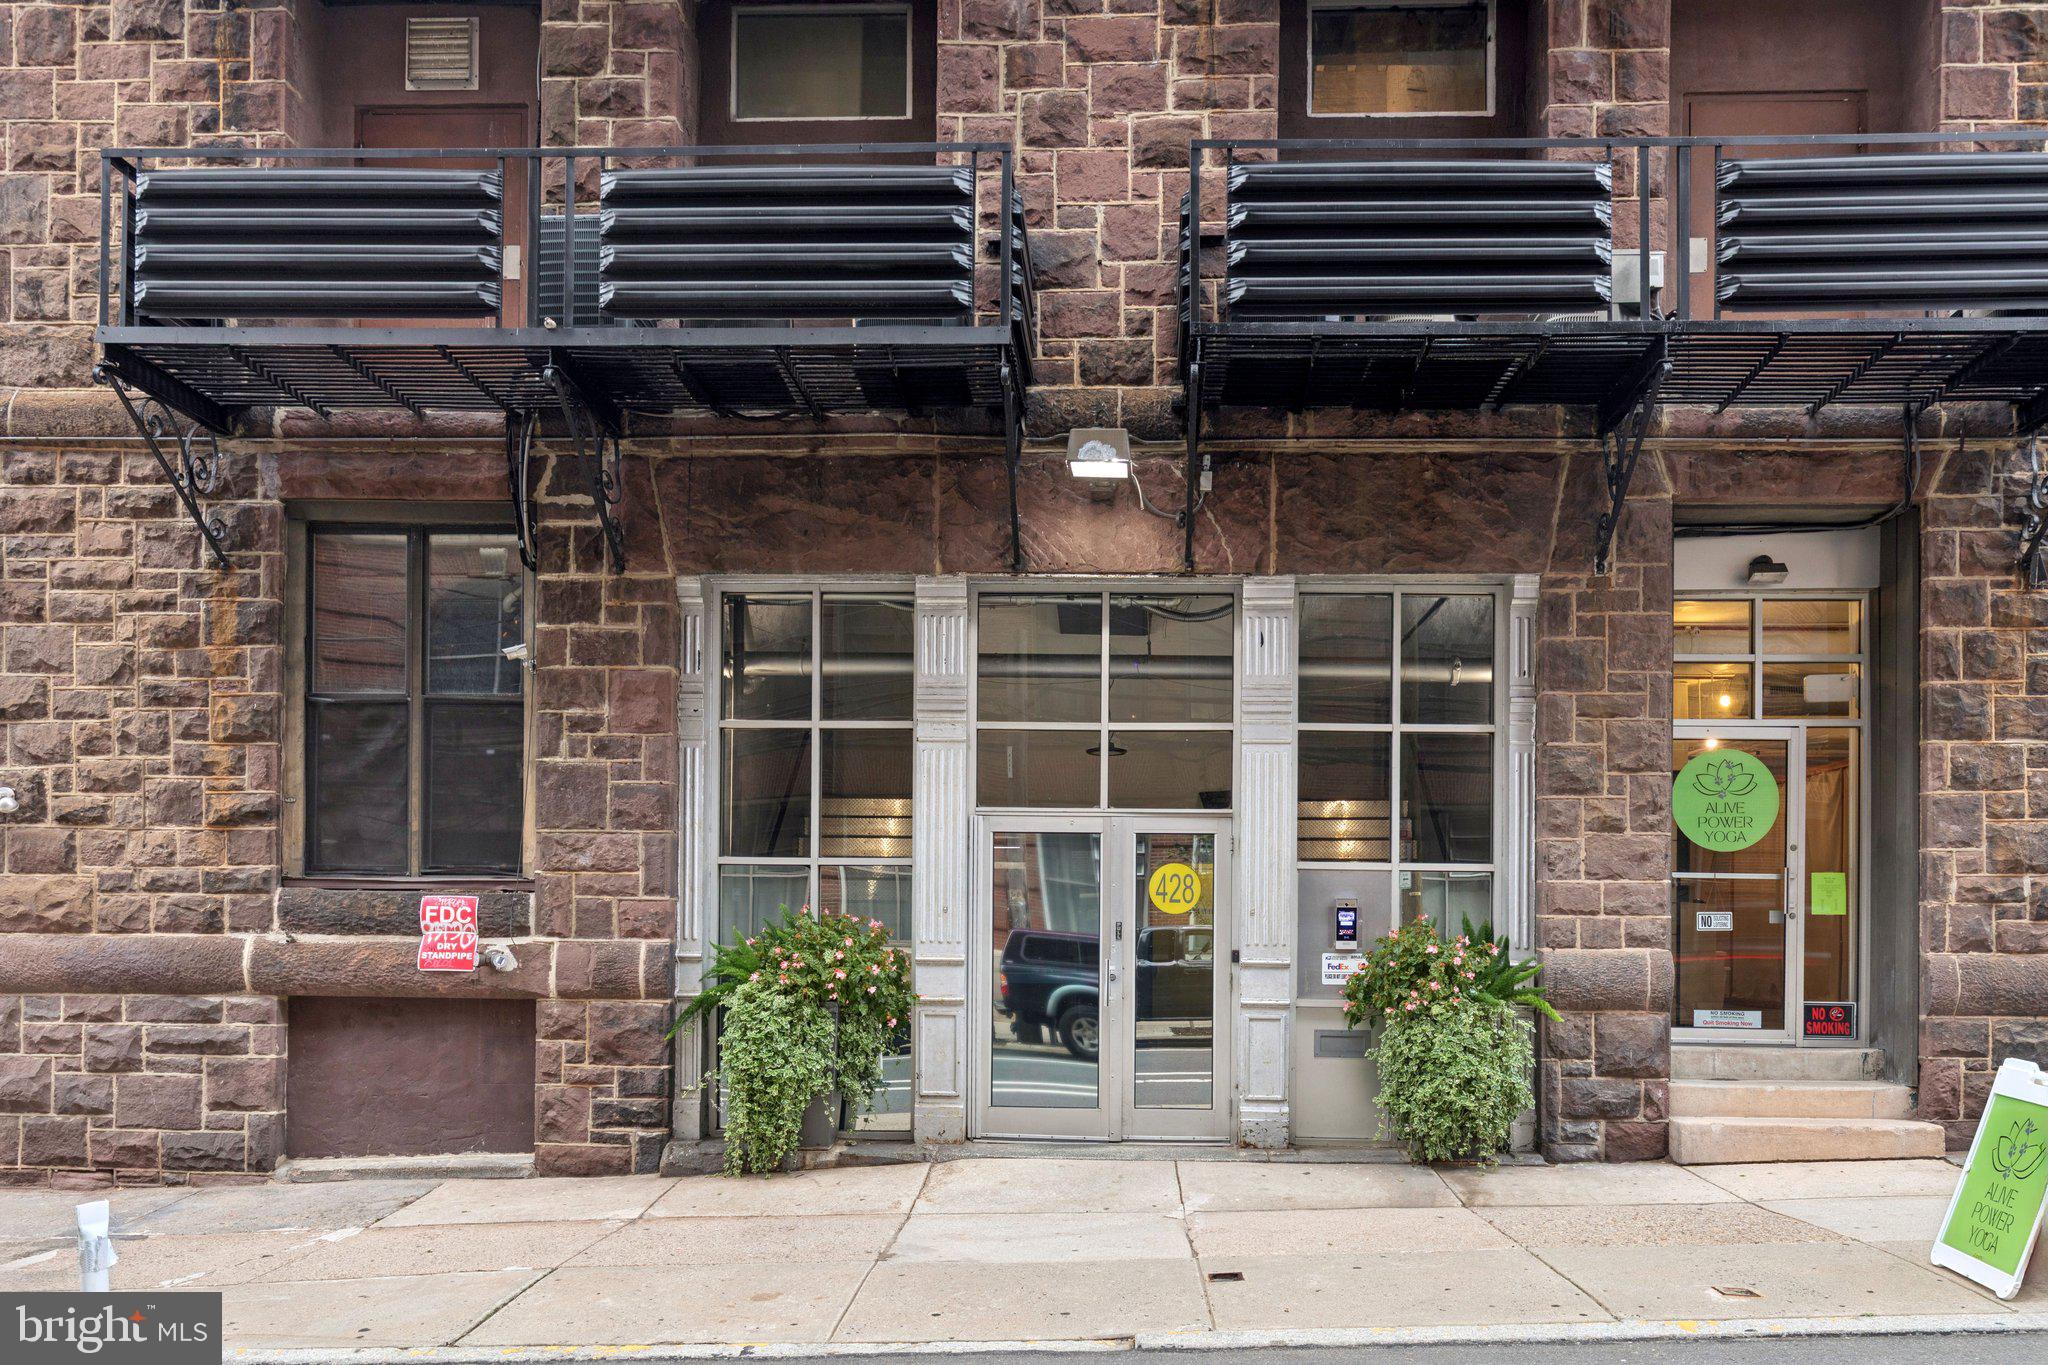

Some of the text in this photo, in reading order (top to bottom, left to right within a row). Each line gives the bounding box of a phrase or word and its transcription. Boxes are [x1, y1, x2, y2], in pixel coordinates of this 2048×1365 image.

[1705, 802, 1745, 814] ALIVE
[1697, 816, 1753, 828] POWER
[1704, 830, 1747, 842] YOGA
[1156, 873, 1194, 904] 428
[425, 905, 472, 924] FDC
[1701, 915, 1712, 927] NO
[437, 942, 458, 951] DRY
[421, 952, 473, 961] STANDPIPE
[1812, 1008, 1826, 1020] NO
[1807, 1022, 1850, 1035] SMOKING
[1985, 1182, 2018, 1208] ALIVE
[1971, 1201, 2015, 1233] POWER
[1969, 1225, 1999, 1254] YOGA
